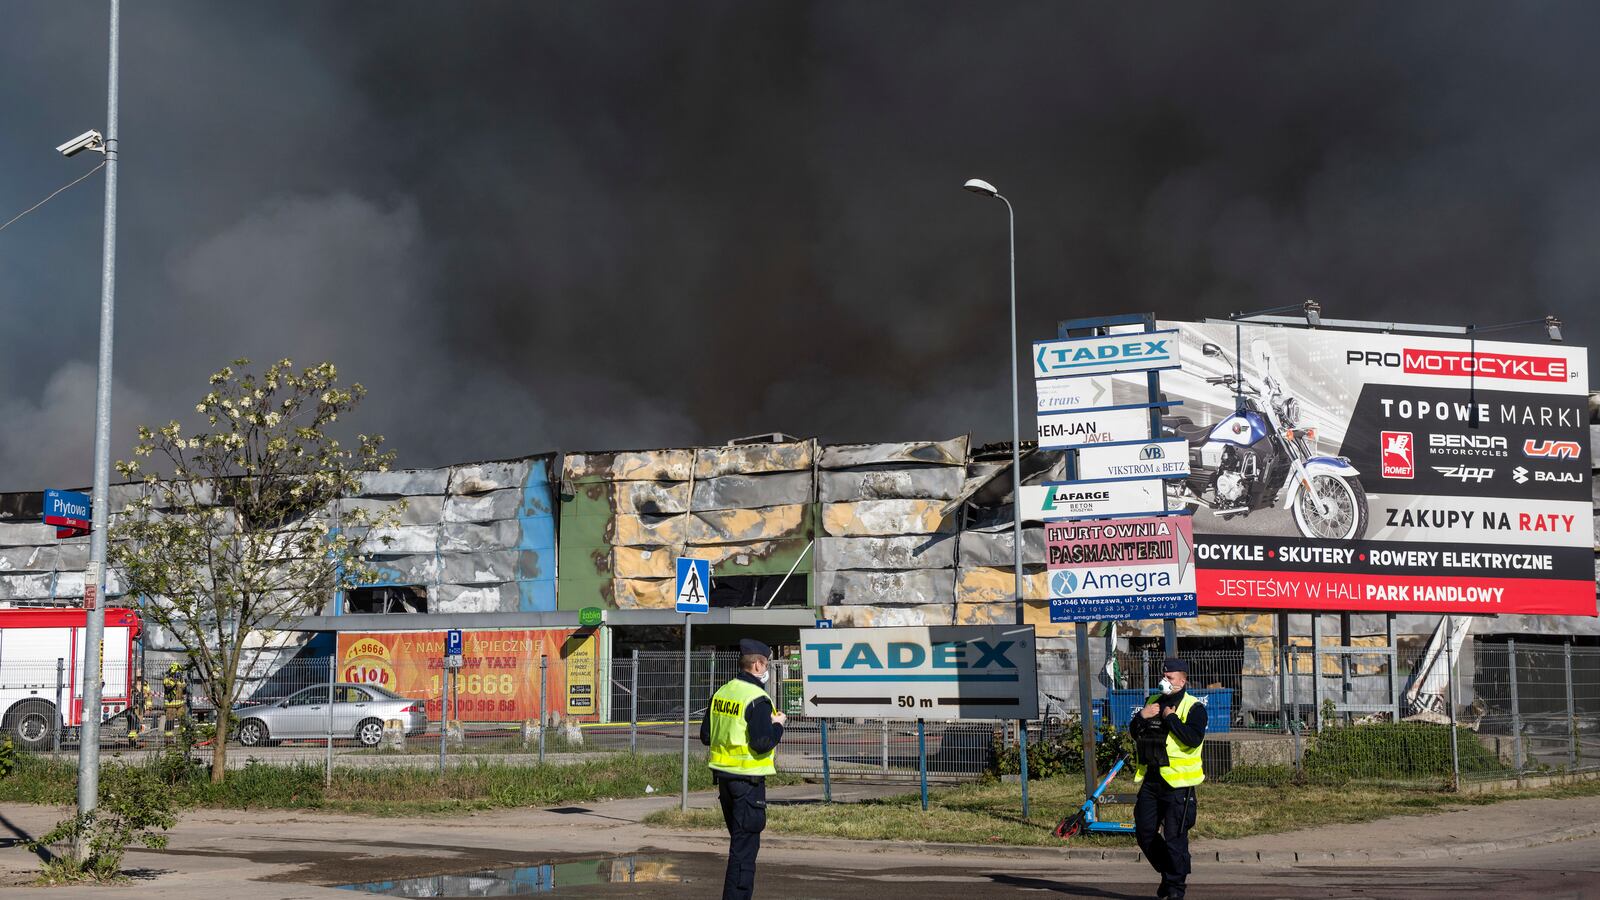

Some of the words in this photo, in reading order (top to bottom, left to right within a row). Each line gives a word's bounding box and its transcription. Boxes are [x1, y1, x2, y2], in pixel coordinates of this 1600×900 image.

[1051, 340, 1168, 362] TADEX
[1381, 399, 1489, 422] TOPOWE
[1501, 404, 1581, 428] MARKI
[1083, 432, 1114, 444] JAVEL
[1429, 433, 1507, 449] BENDA
[1144, 447, 1161, 459] VB
[1430, 448, 1508, 457] MOTORCYCLES
[1108, 463, 1154, 475] VIKSTROM
[1162, 461, 1185, 472] BETZ
[1384, 466, 1411, 475] ROMET
[1535, 471, 1583, 483] BAJAJ
[1053, 491, 1110, 501] LAFARGE
[53, 499, 86, 517] Płytowa
[1386, 508, 1474, 529] ZAKUPY
[1482, 510, 1511, 531] NA
[1519, 513, 1574, 533] RATY
[1049, 522, 1171, 541] HURTOWNIA
[1050, 541, 1173, 564] PASMANTERII
[1279, 546, 1354, 564] SKUTERY
[1369, 550, 1438, 567] ROWERY
[1442, 552, 1553, 570] ELEKTRYCZNE
[1082, 571, 1171, 592] Amegra
[1216, 577, 1299, 598] JESTEŚMY
[1304, 581, 1322, 599] W
[1326, 582, 1361, 600] HALI
[1366, 584, 1409, 602] PARK
[1413, 585, 1504, 604] HANDLOWY
[1136, 595, 1181, 603] Kaczorowa
[450, 632, 459, 648] P
[464, 640, 543, 652] EZPIECZNIE
[486, 657, 517, 669] TAXI
[805, 641, 1018, 669] TADEX
[345, 665, 389, 685] Glob
[713, 699, 740, 716] POLICJA
[898, 695, 915, 708] 50
[920, 698, 933, 708] m
